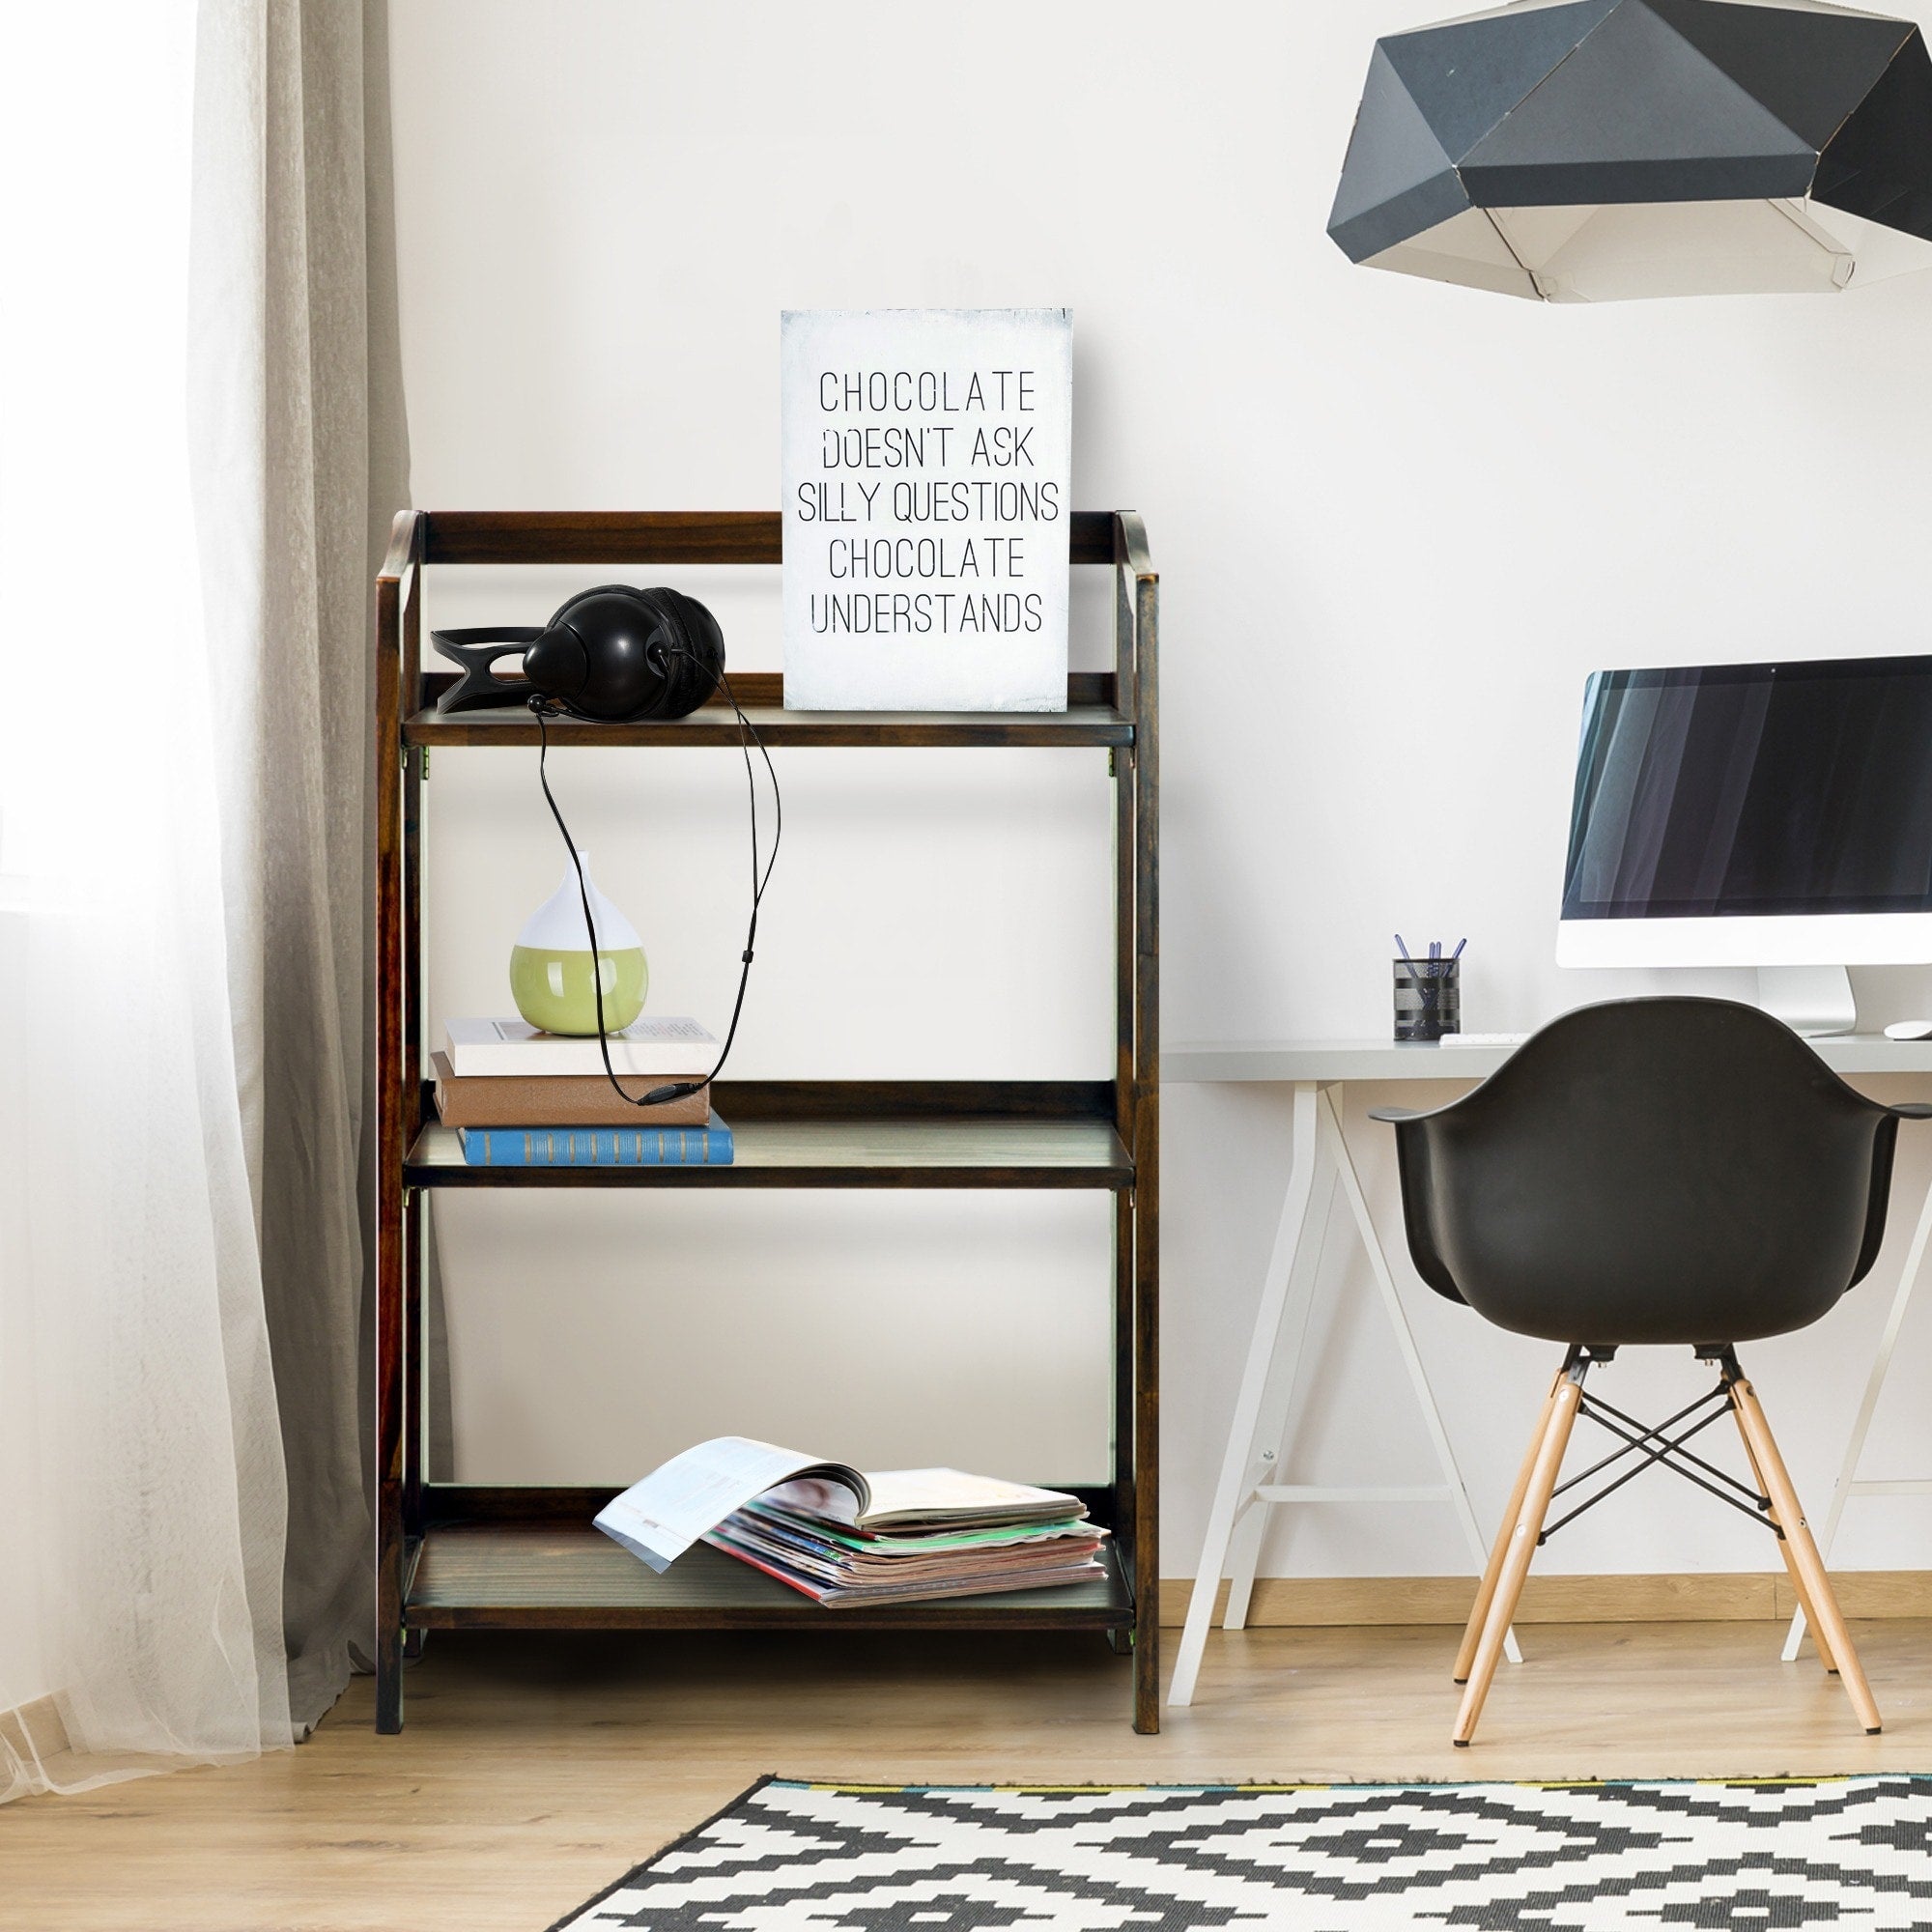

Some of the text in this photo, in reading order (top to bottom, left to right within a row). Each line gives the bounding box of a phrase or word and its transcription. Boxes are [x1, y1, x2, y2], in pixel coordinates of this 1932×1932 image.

[821, 371, 1035, 412] CHOCOLATE
[823, 427, 1035, 469] DOESN'T ASK
[798, 482, 1059, 524] SILLY QUESTIONS
[830, 538, 1024, 579] CHOCOLATE
[810, 593, 1042, 634] UNDERSTANDS
